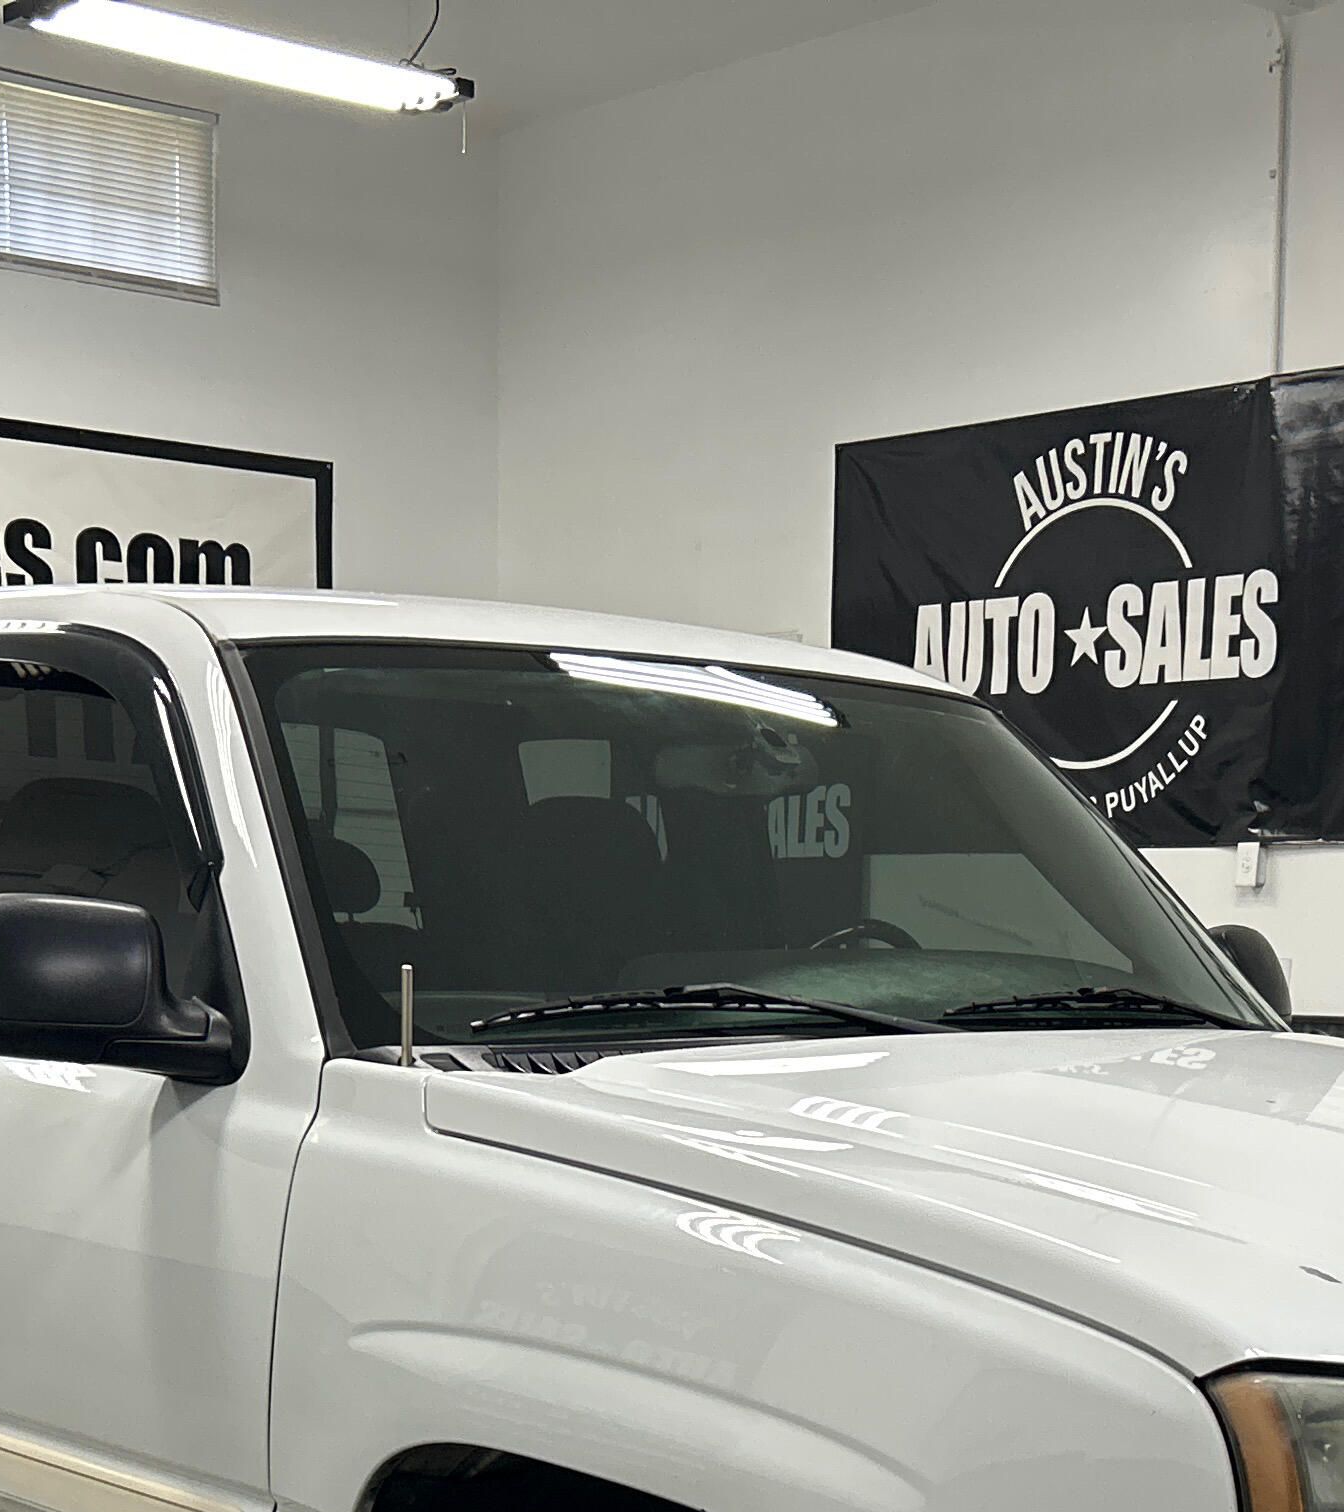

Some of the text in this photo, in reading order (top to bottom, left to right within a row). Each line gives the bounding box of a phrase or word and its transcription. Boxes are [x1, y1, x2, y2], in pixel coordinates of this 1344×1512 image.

[1012, 431, 1188, 531] AUSTIN'S
[913, 569, 1279, 698] AUTO SALES
[1105, 714, 1208, 819] PUYALLUP
[764, 783, 851, 859] ALES
